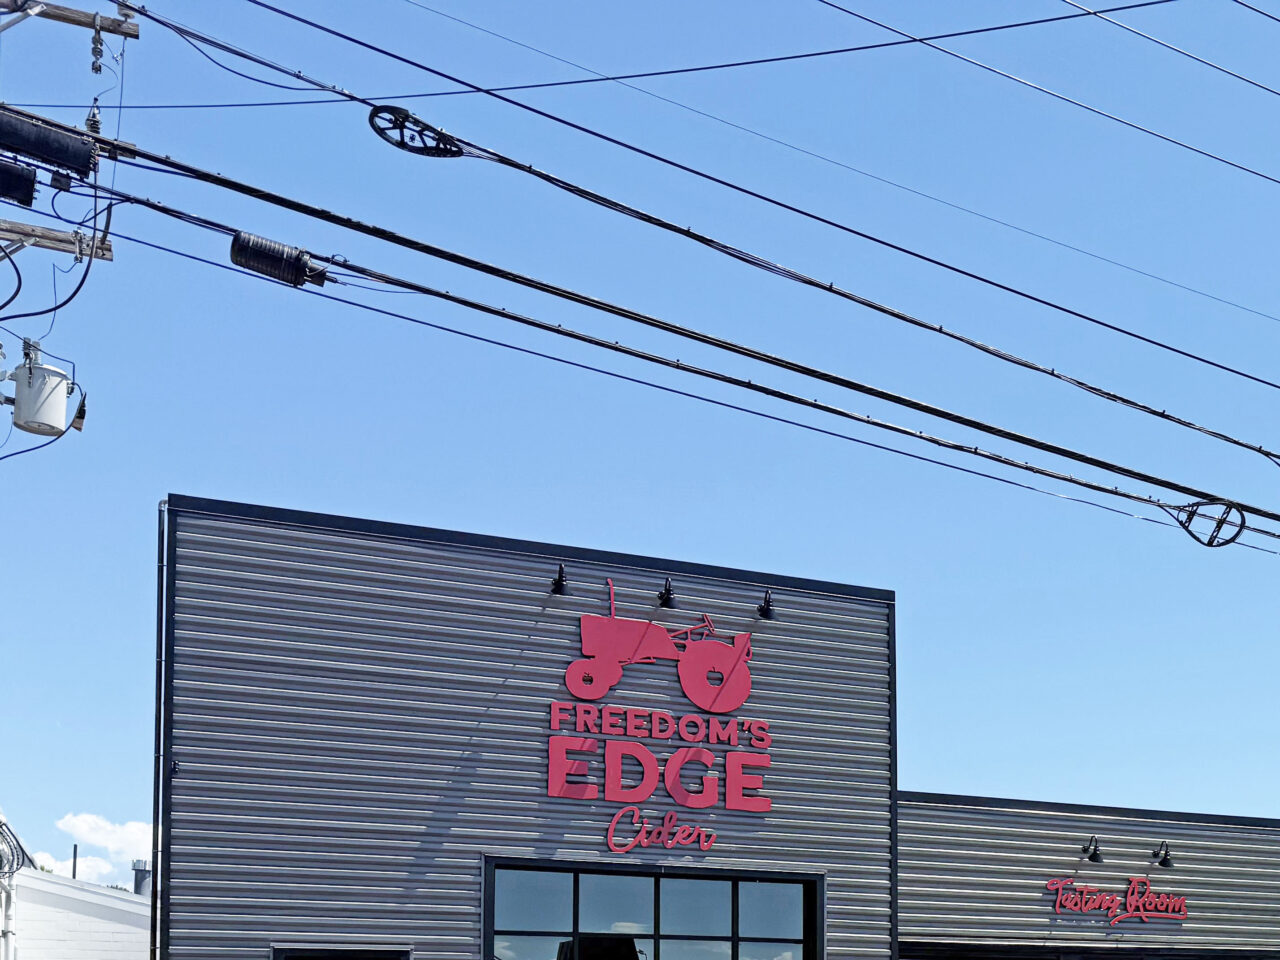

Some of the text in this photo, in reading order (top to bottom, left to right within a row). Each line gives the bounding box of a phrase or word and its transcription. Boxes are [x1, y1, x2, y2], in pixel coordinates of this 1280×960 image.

[551, 701, 772, 748] FREEDOM'S
[548, 736, 771, 812] EDGE
[607, 806, 717, 853] Cider
[1046, 877, 1187, 926] Tasting Room
